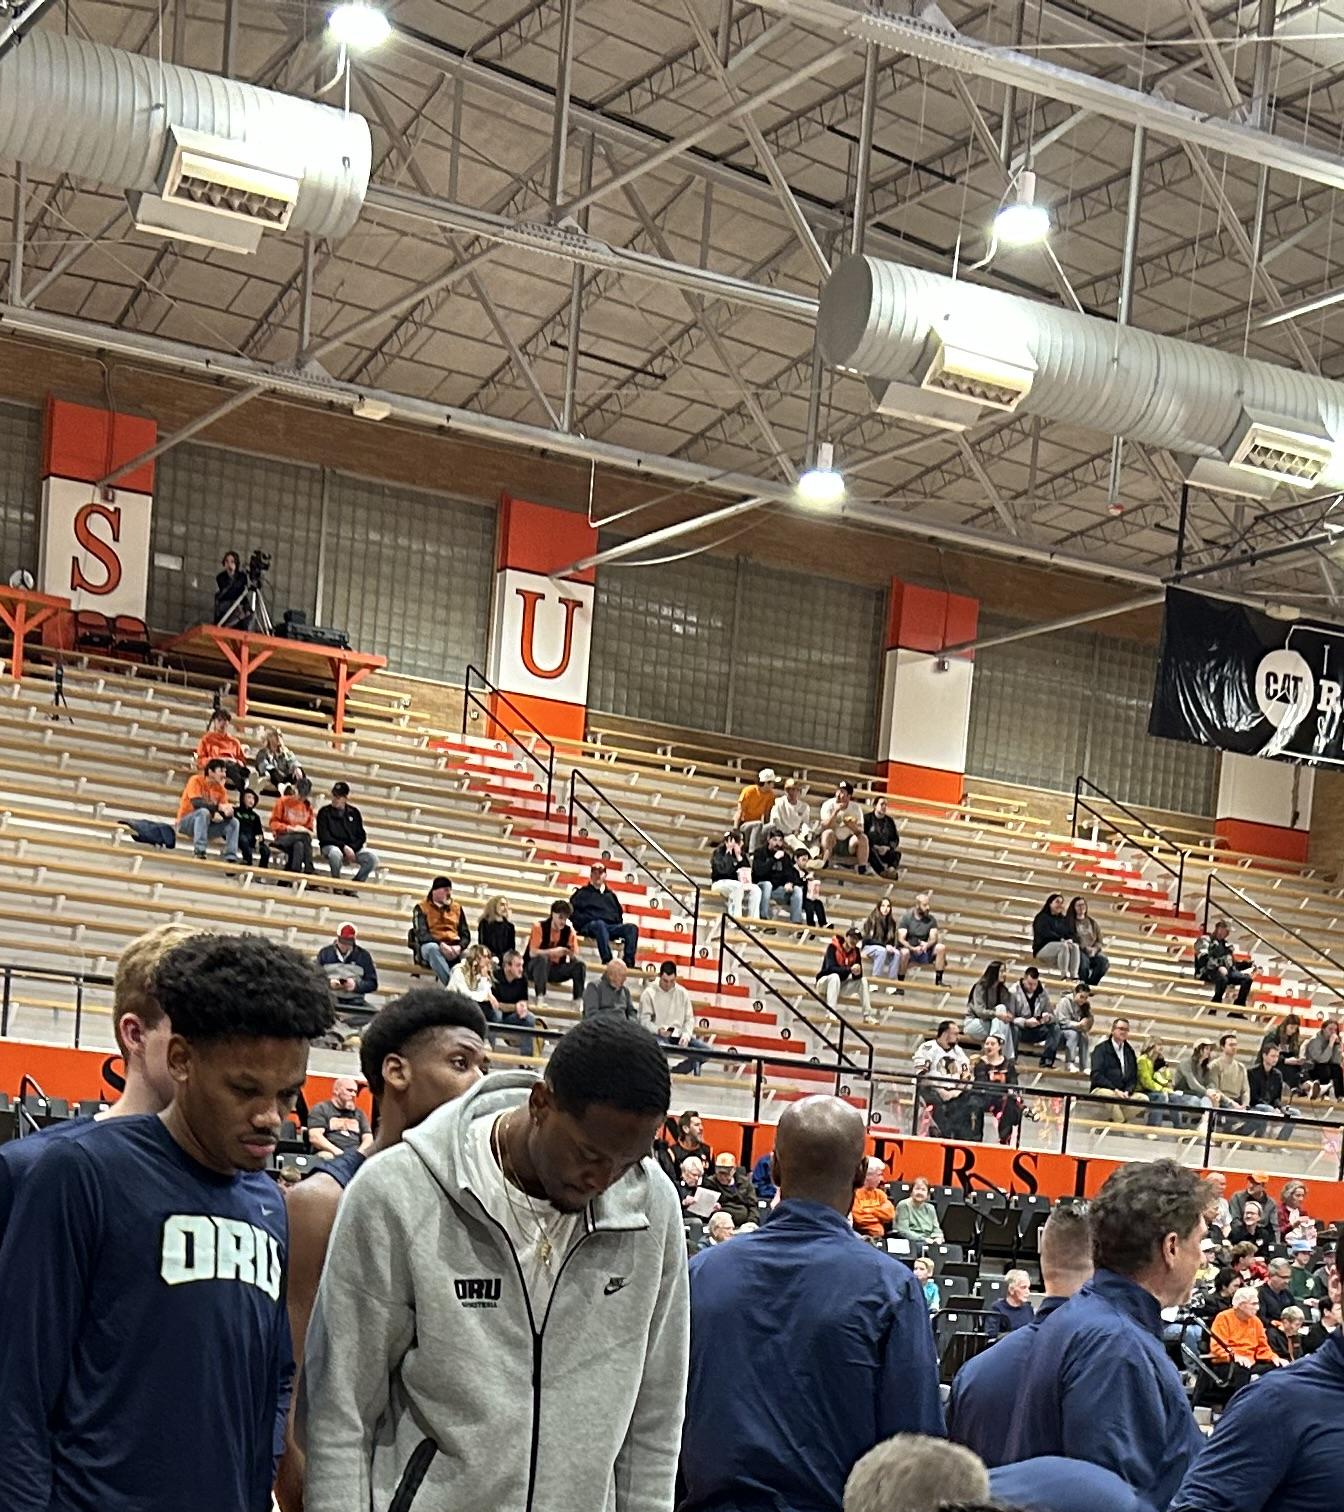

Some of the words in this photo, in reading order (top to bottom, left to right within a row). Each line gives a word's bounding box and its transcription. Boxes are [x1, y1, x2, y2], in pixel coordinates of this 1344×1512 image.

[69, 500, 125, 596] S
[512, 588, 584, 681] U
[1264, 671, 1304, 705] CAT
[160, 1213, 281, 1300] ORU
[454, 1278, 502, 1300] ORU
